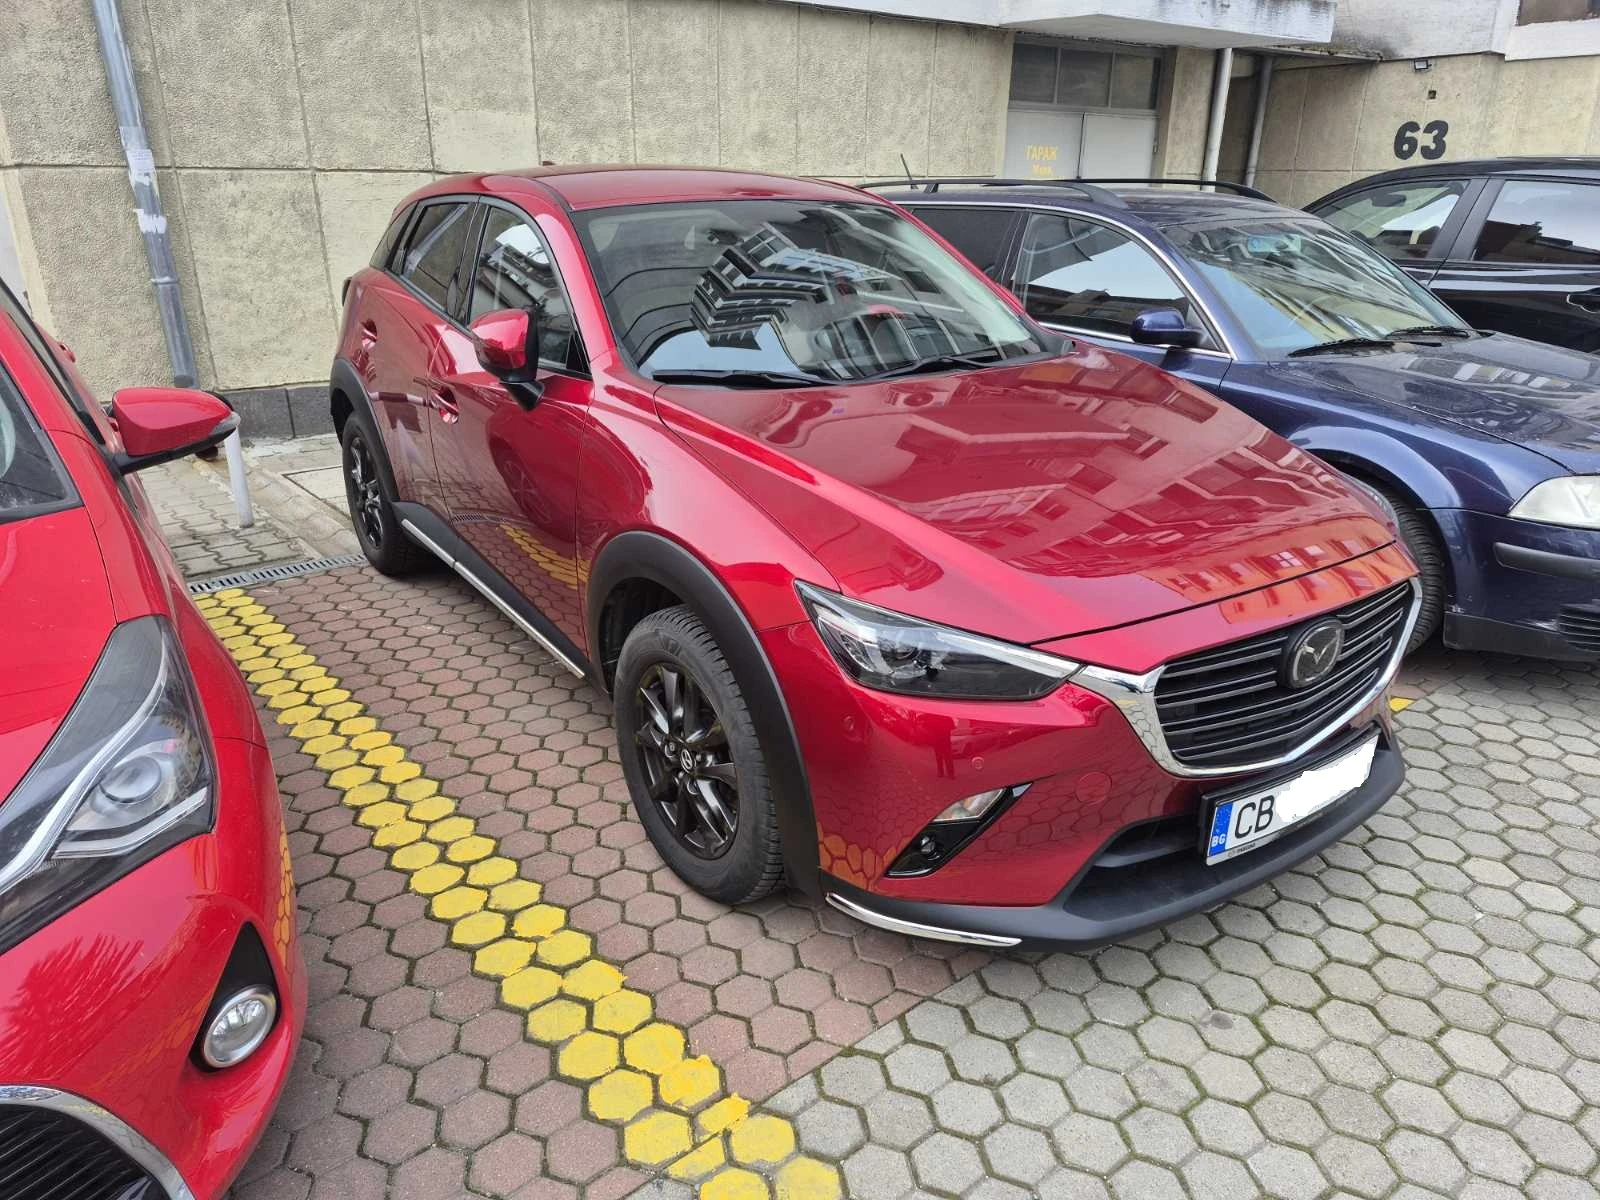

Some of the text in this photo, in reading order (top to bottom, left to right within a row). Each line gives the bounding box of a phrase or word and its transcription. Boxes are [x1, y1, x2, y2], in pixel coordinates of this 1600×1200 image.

[1026, 144, 1058, 160] ГАРАЖ
[1394, 120, 1448, 160] 63
[1235, 795, 1275, 838] CB
[1212, 834, 1226, 847] BG
